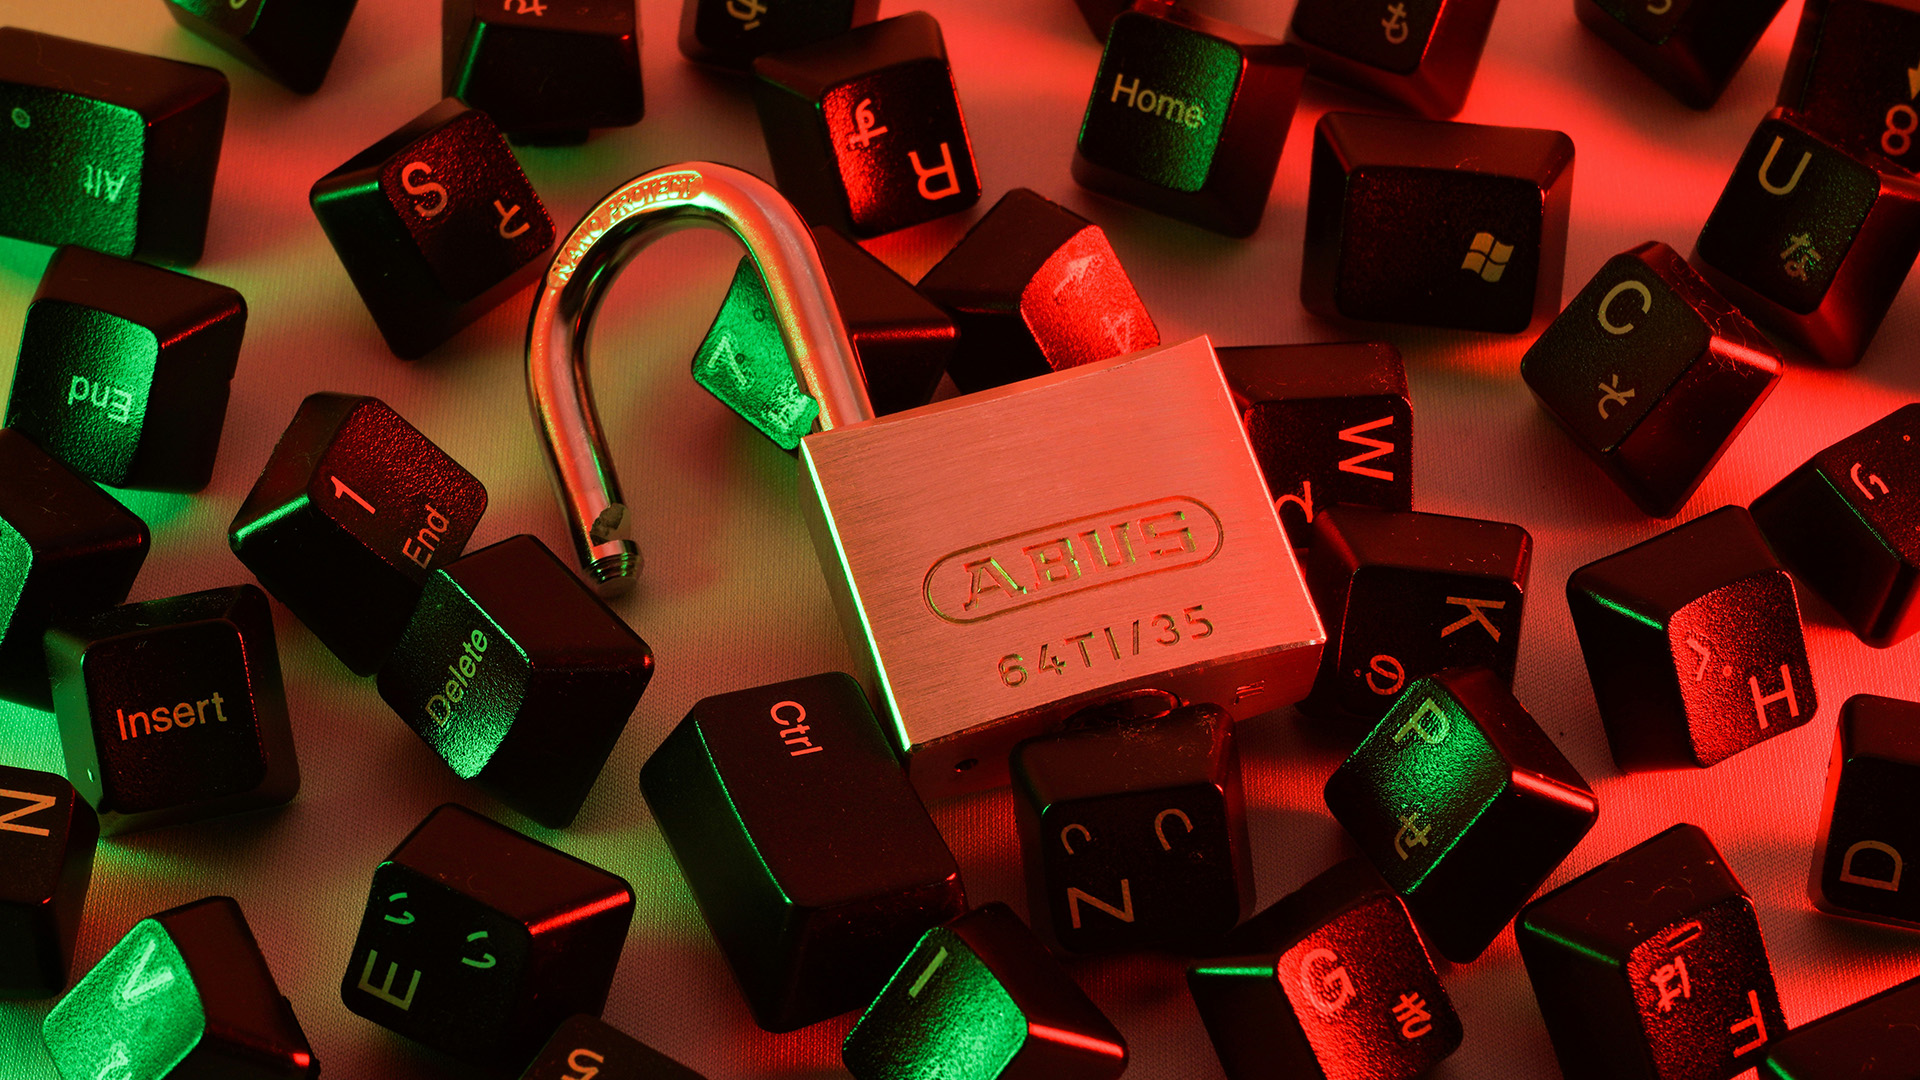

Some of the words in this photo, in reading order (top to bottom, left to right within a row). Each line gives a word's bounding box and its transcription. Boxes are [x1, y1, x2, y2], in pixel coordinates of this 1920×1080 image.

[844, 97, 888, 149] す
[1111, 73, 1203, 130] Home
[1881, 103, 1918, 156] 8
[83, 164, 126, 202] Alt
[401, 161, 449, 217] S
[908, 141, 963, 201] R
[1758, 135, 1813, 196] U
[493, 199, 530, 240] と
[552, 212, 604, 282] NANO
[609, 175, 697, 224] PROTECT
[1779, 232, 1823, 282] な
[1598, 279, 1652, 335] C
[67, 374, 134, 424] End
[1597, 373, 1636, 419] そ
[1338, 415, 1395, 482] W
[330, 475, 376, 514] 1
[1850, 462, 1889, 500] り
[402, 503, 450, 570] End
[962, 510, 1198, 612] ABUS
[997, 603, 1214, 689] 64TI/35
[1440, 595, 1506, 643] K
[425, 629, 489, 727] Delete
[1365, 652, 1407, 697] の
[1686, 638, 1711, 682] く
[116, 692, 227, 741] Insert
[1393, 697, 1450, 746] P
[1749, 664, 1801, 731] H
[770, 700, 824, 757] Ctrl
[1393, 812, 1433, 862] せ
[1839, 839, 1904, 893] D
[115, 938, 176, 1008] V
[356, 948, 422, 1013] E
[1300, 947, 1358, 1016] G
[1648, 956, 1692, 1013] は
[1391, 991, 1434, 1040] き
[1729, 989, 1768, 1058] F
